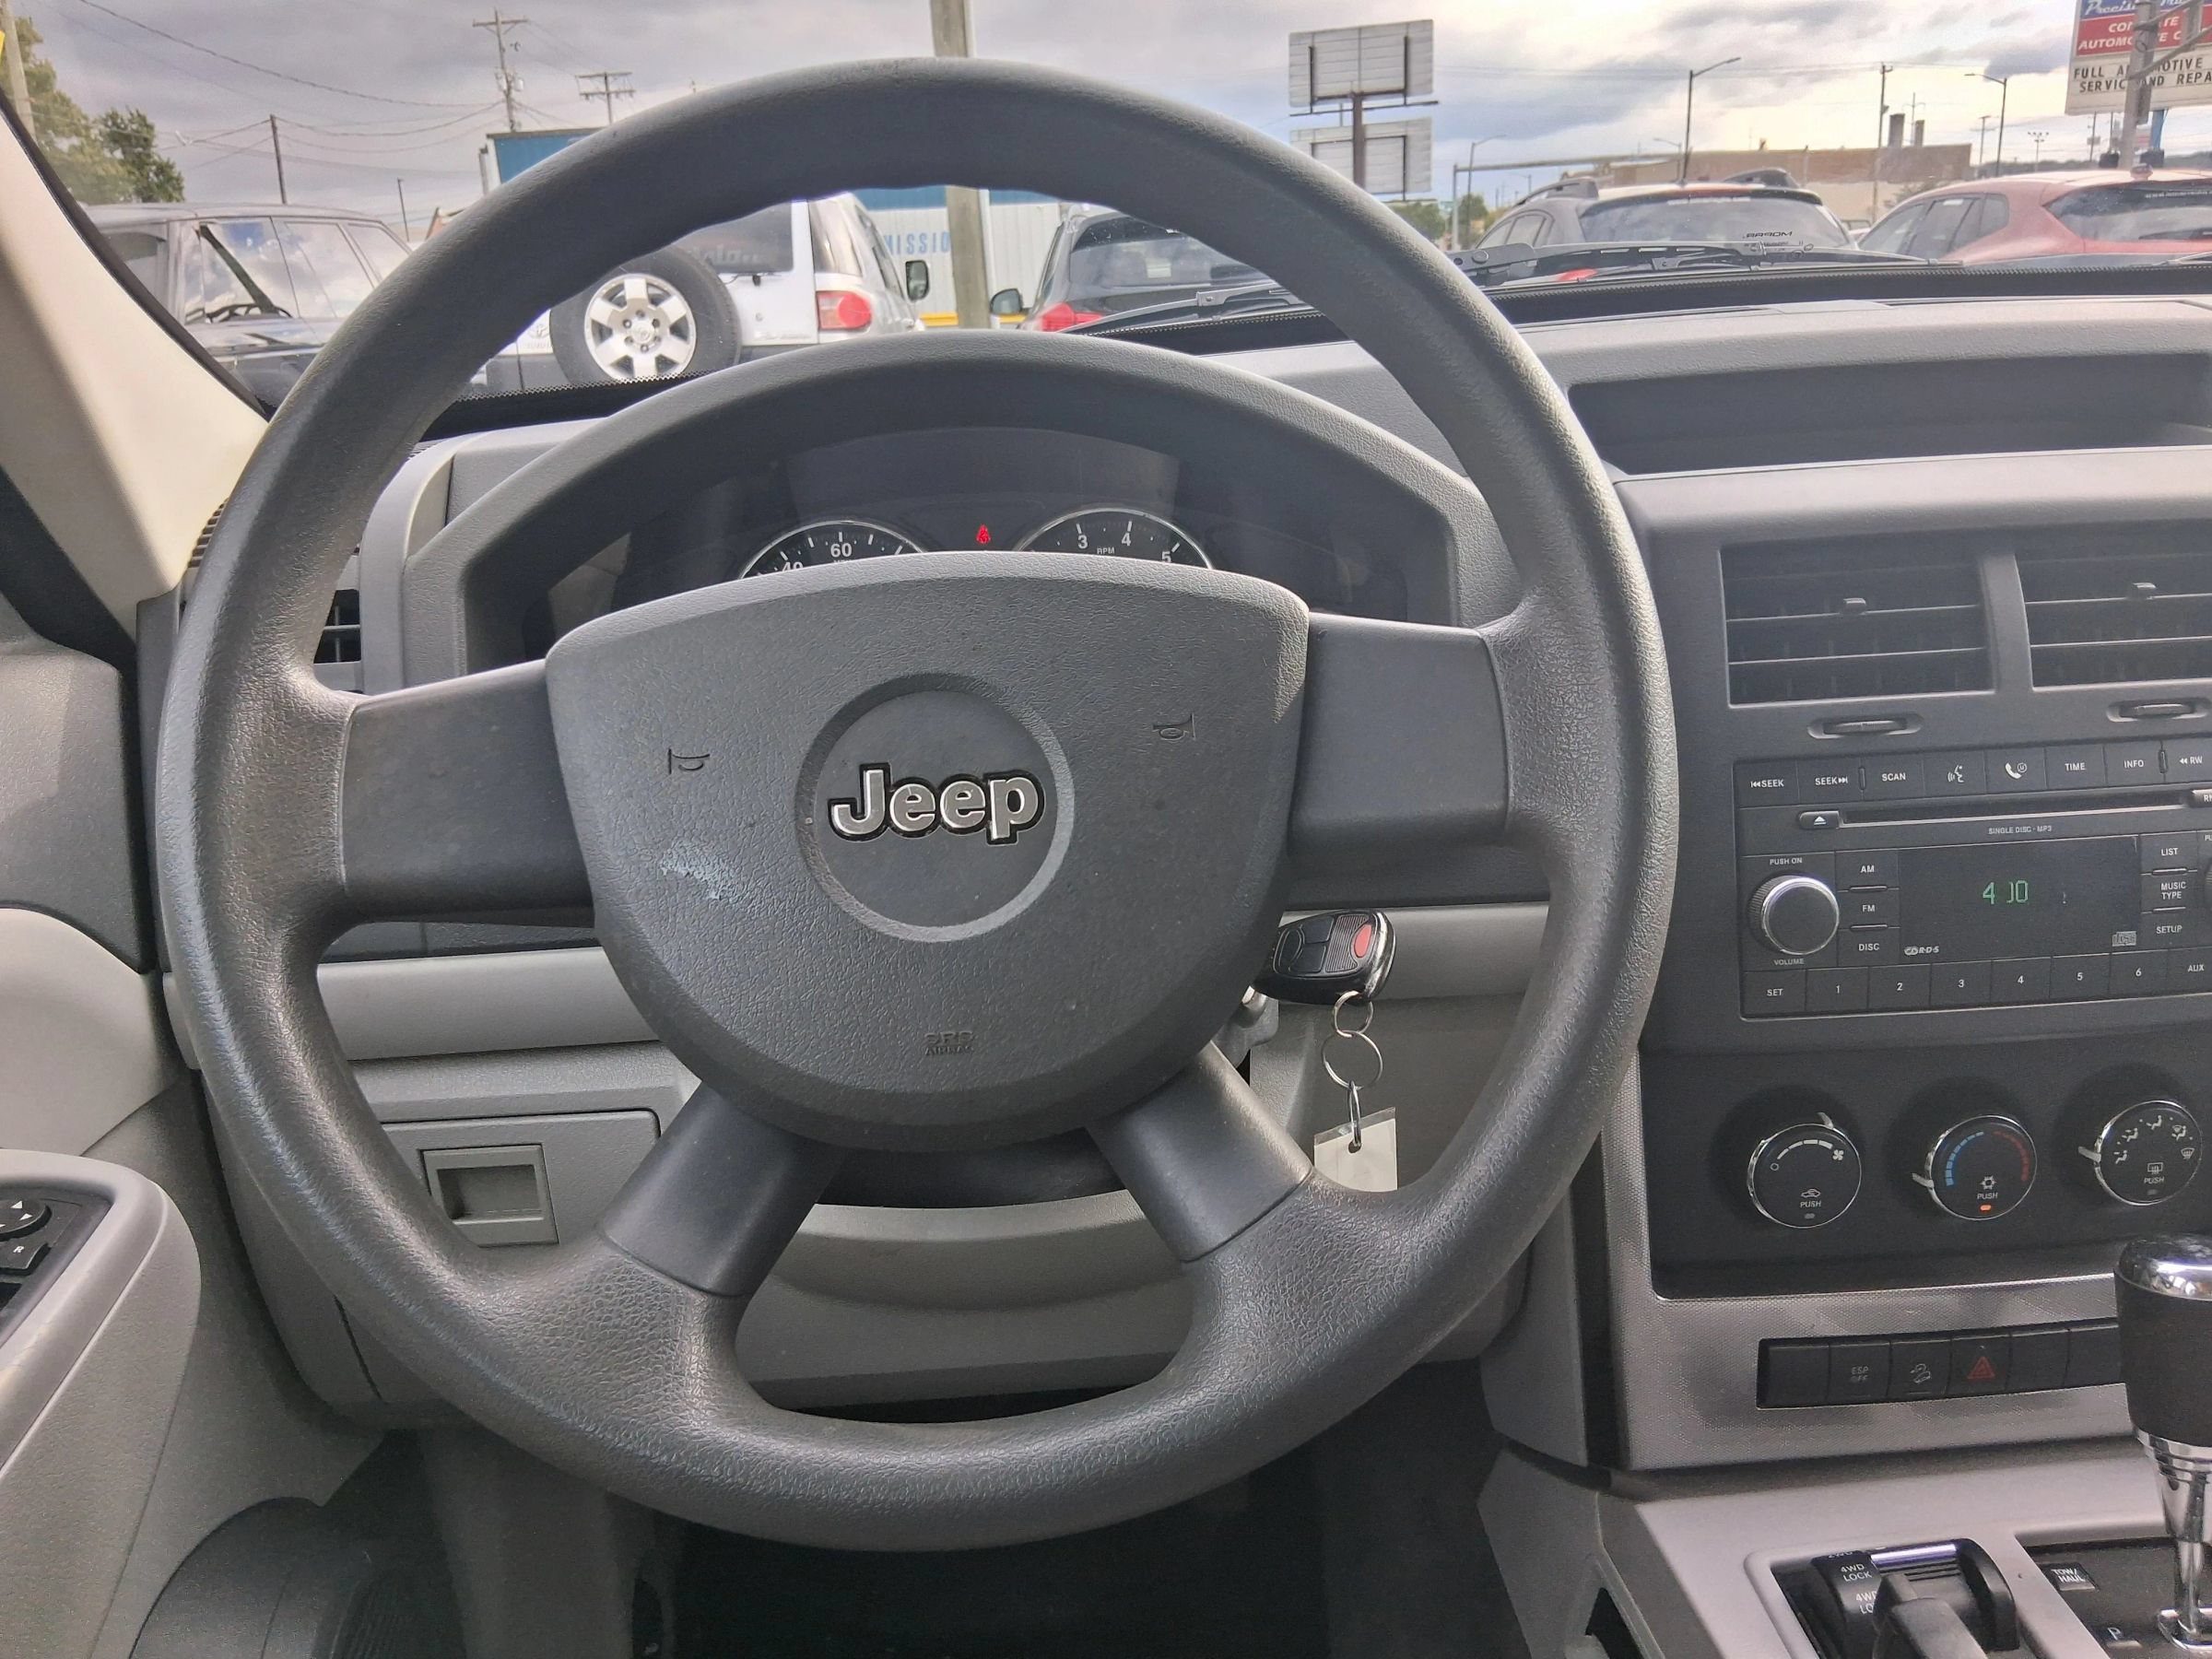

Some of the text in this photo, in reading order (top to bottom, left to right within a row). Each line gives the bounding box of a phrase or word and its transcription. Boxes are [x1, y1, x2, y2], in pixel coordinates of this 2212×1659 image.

[2074, 58, 2203, 79] FULL AOTIVE
[2079, 78, 2126, 93] SERVIC
[1077, 535, 1088, 549] 3
[1121, 532, 1132, 547] 4
[830, 542, 853, 558] 60
[1097, 547, 1115, 555] RPM
[1161, 551, 1171, 563] 5
[2124, 759, 2145, 769] INFO
[2190, 757, 2203, 765] RW
[2065, 762, 2086, 771] TIME
[1815, 776, 1838, 785] SEEK
[1881, 772, 1906, 782] SCAN
[1761, 779, 1784, 788] SEEK
[830, 766, 1043, 843] Jeep
[1988, 827, 2014, 835] SINGLE
[2160, 848, 2179, 856] LIST
[2160, 881, 2187, 890] MUSIC
[2161, 890, 2183, 900] TYPE
[1862, 904, 1876, 912] FM
[2156, 925, 2183, 934] SETUP
[1773, 958, 1805, 966] VOLUME
[2136, 968, 2142, 977] 6
[2187, 964, 2205, 972] AUX
[2017, 975, 2024, 983] 4
[2077, 972, 2083, 981] 5
[1897, 982, 1903, 991] 2
[1958, 980, 1965, 988] 3
[1836, 985, 1841, 994] 1
[2144, 1176, 2165, 1184] PUSH
[13, 1245, 24, 1253] R
[1852, 1366, 1869, 1375] ESP
[1841, 1563, 1865, 1573] 4WD
[1843, 1571, 1872, 1583] LOCK
[2058, 1574, 2086, 1583] HAUL
